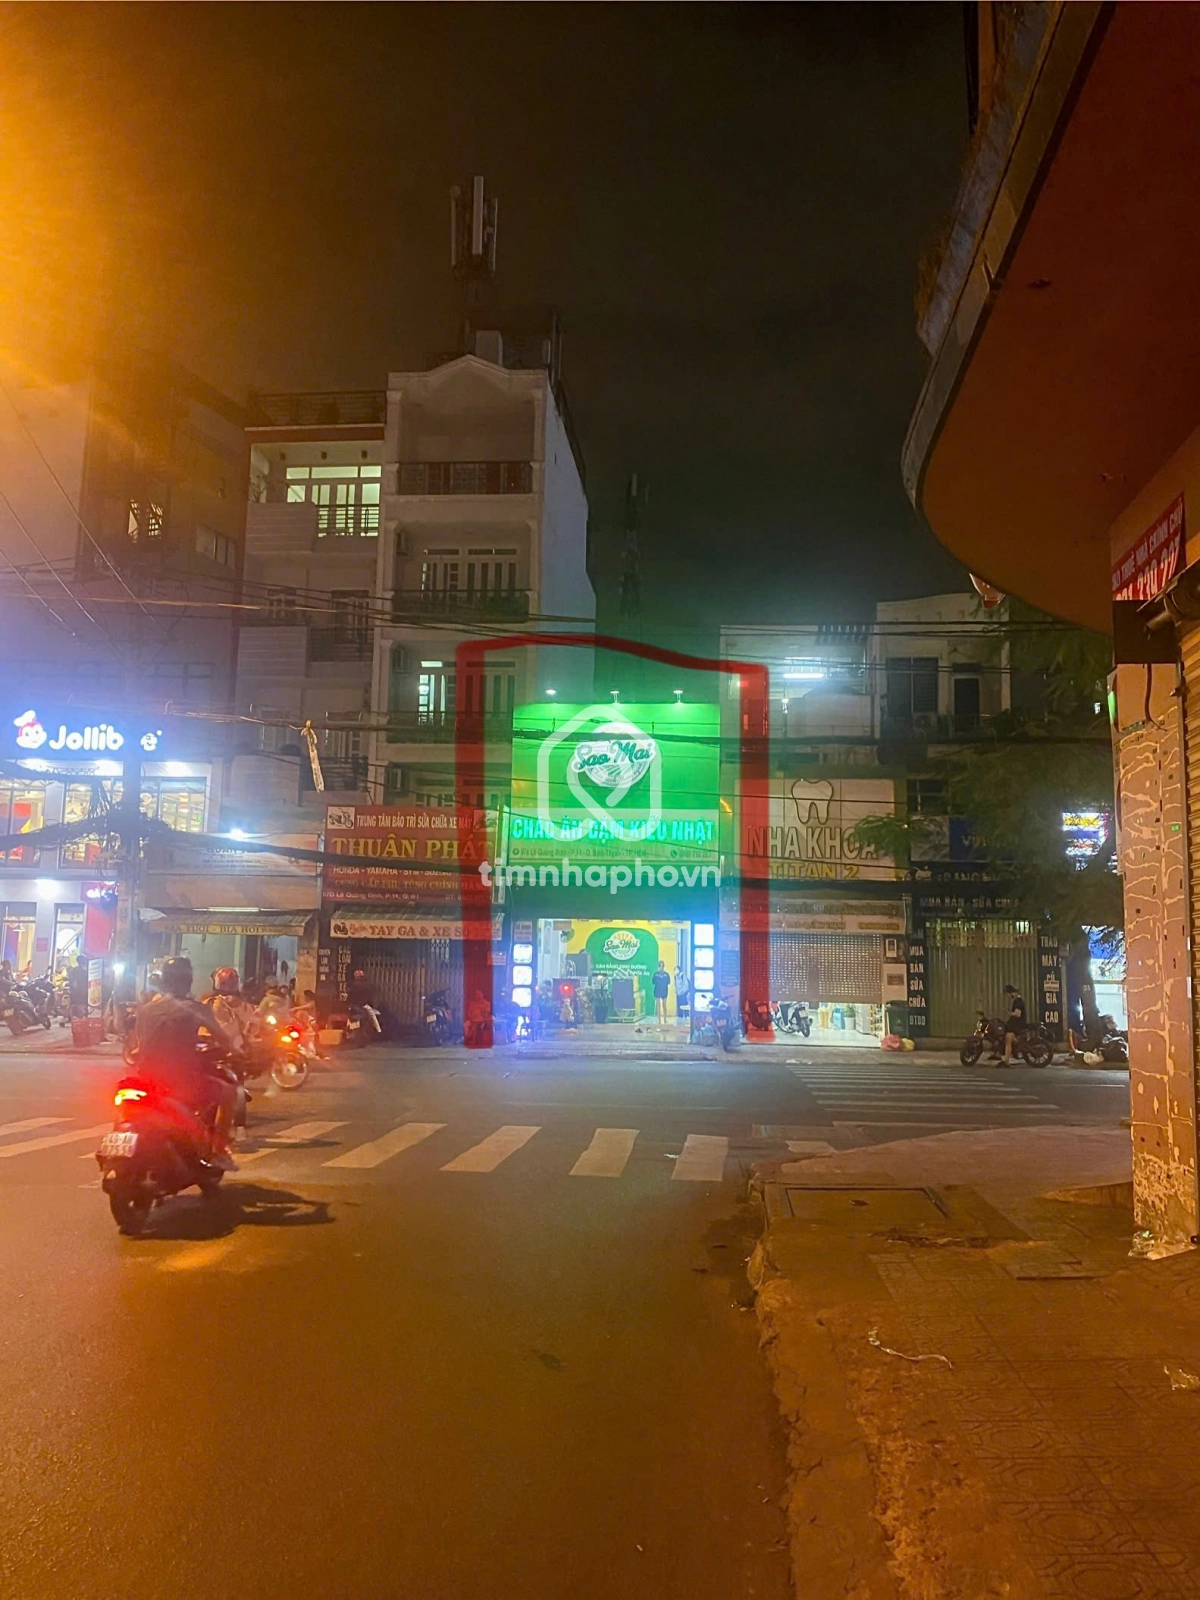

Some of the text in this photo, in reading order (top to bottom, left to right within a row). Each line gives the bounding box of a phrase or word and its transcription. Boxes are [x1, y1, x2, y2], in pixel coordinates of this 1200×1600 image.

[573, 740, 654, 770] Sao Mai
[356, 814, 377, 828] TRUNG
[378, 811, 391, 828] TÂM
[405, 813, 416, 829] TRÌ
[448, 816, 458, 830] XE
[512, 815, 555, 840] CHÁO
[561, 814, 583, 840] ĂN
[588, 815, 625, 844] DẶM
[671, 816, 715, 845] NHẬT
[425, 832, 494, 861] PHÁT
[748, 826, 802, 858] NHA
[333, 866, 360, 875] HONDA
[366, 866, 398, 876] YAMAHA
[844, 864, 860, 880] 2
[369, 924, 396, 937] TAY
[397, 925, 416, 937] GA
[432, 926, 450, 938] XE
[909, 945, 924, 957] MUA
[909, 960, 924, 974] BÁN
[1044, 1010, 1059, 1024] CAO
